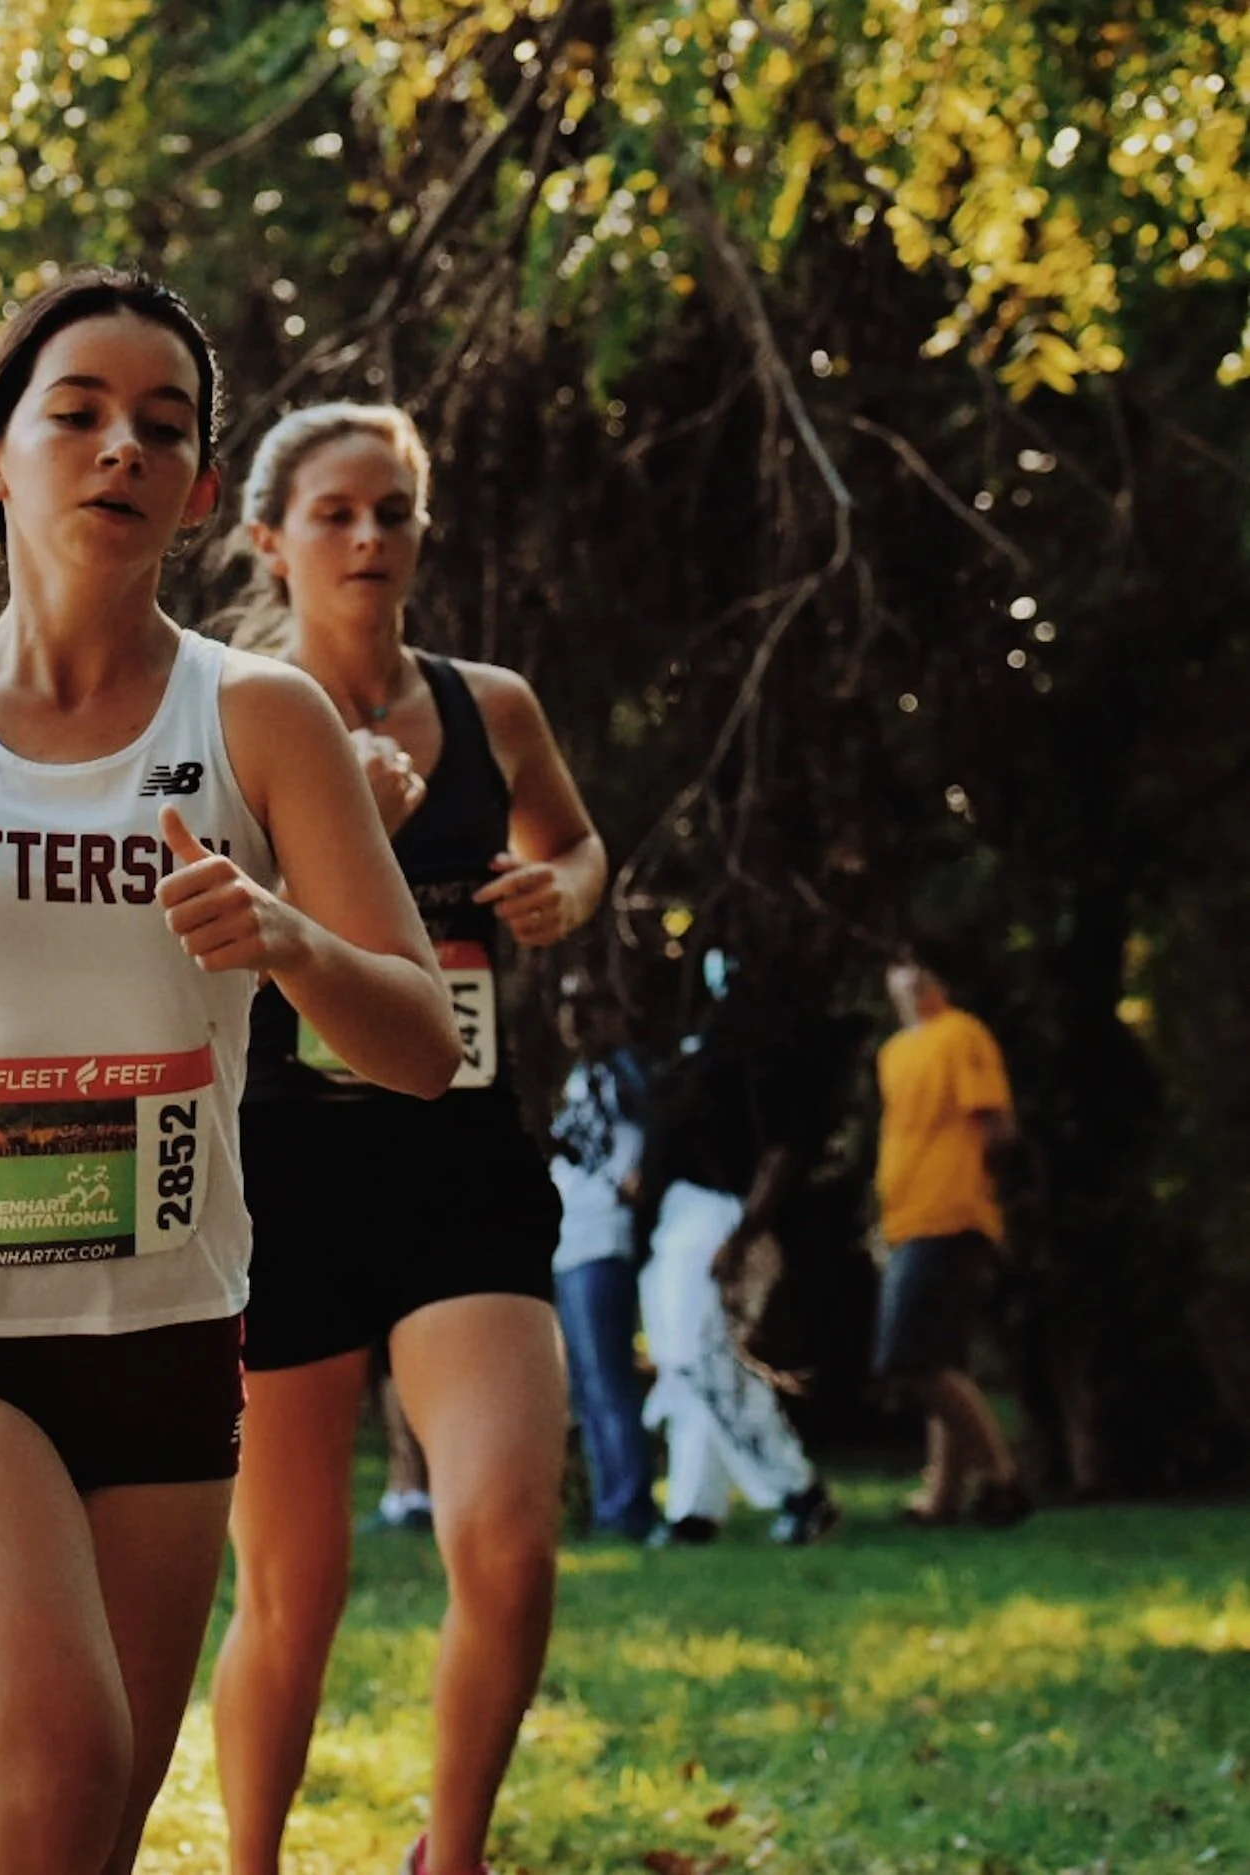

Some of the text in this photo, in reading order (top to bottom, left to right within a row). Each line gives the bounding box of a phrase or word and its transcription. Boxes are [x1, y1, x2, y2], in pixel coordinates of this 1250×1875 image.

[451, 982, 480, 1069] 2471
[104, 1063, 166, 1086] FEET
[156, 1100, 198, 1231] 2852
